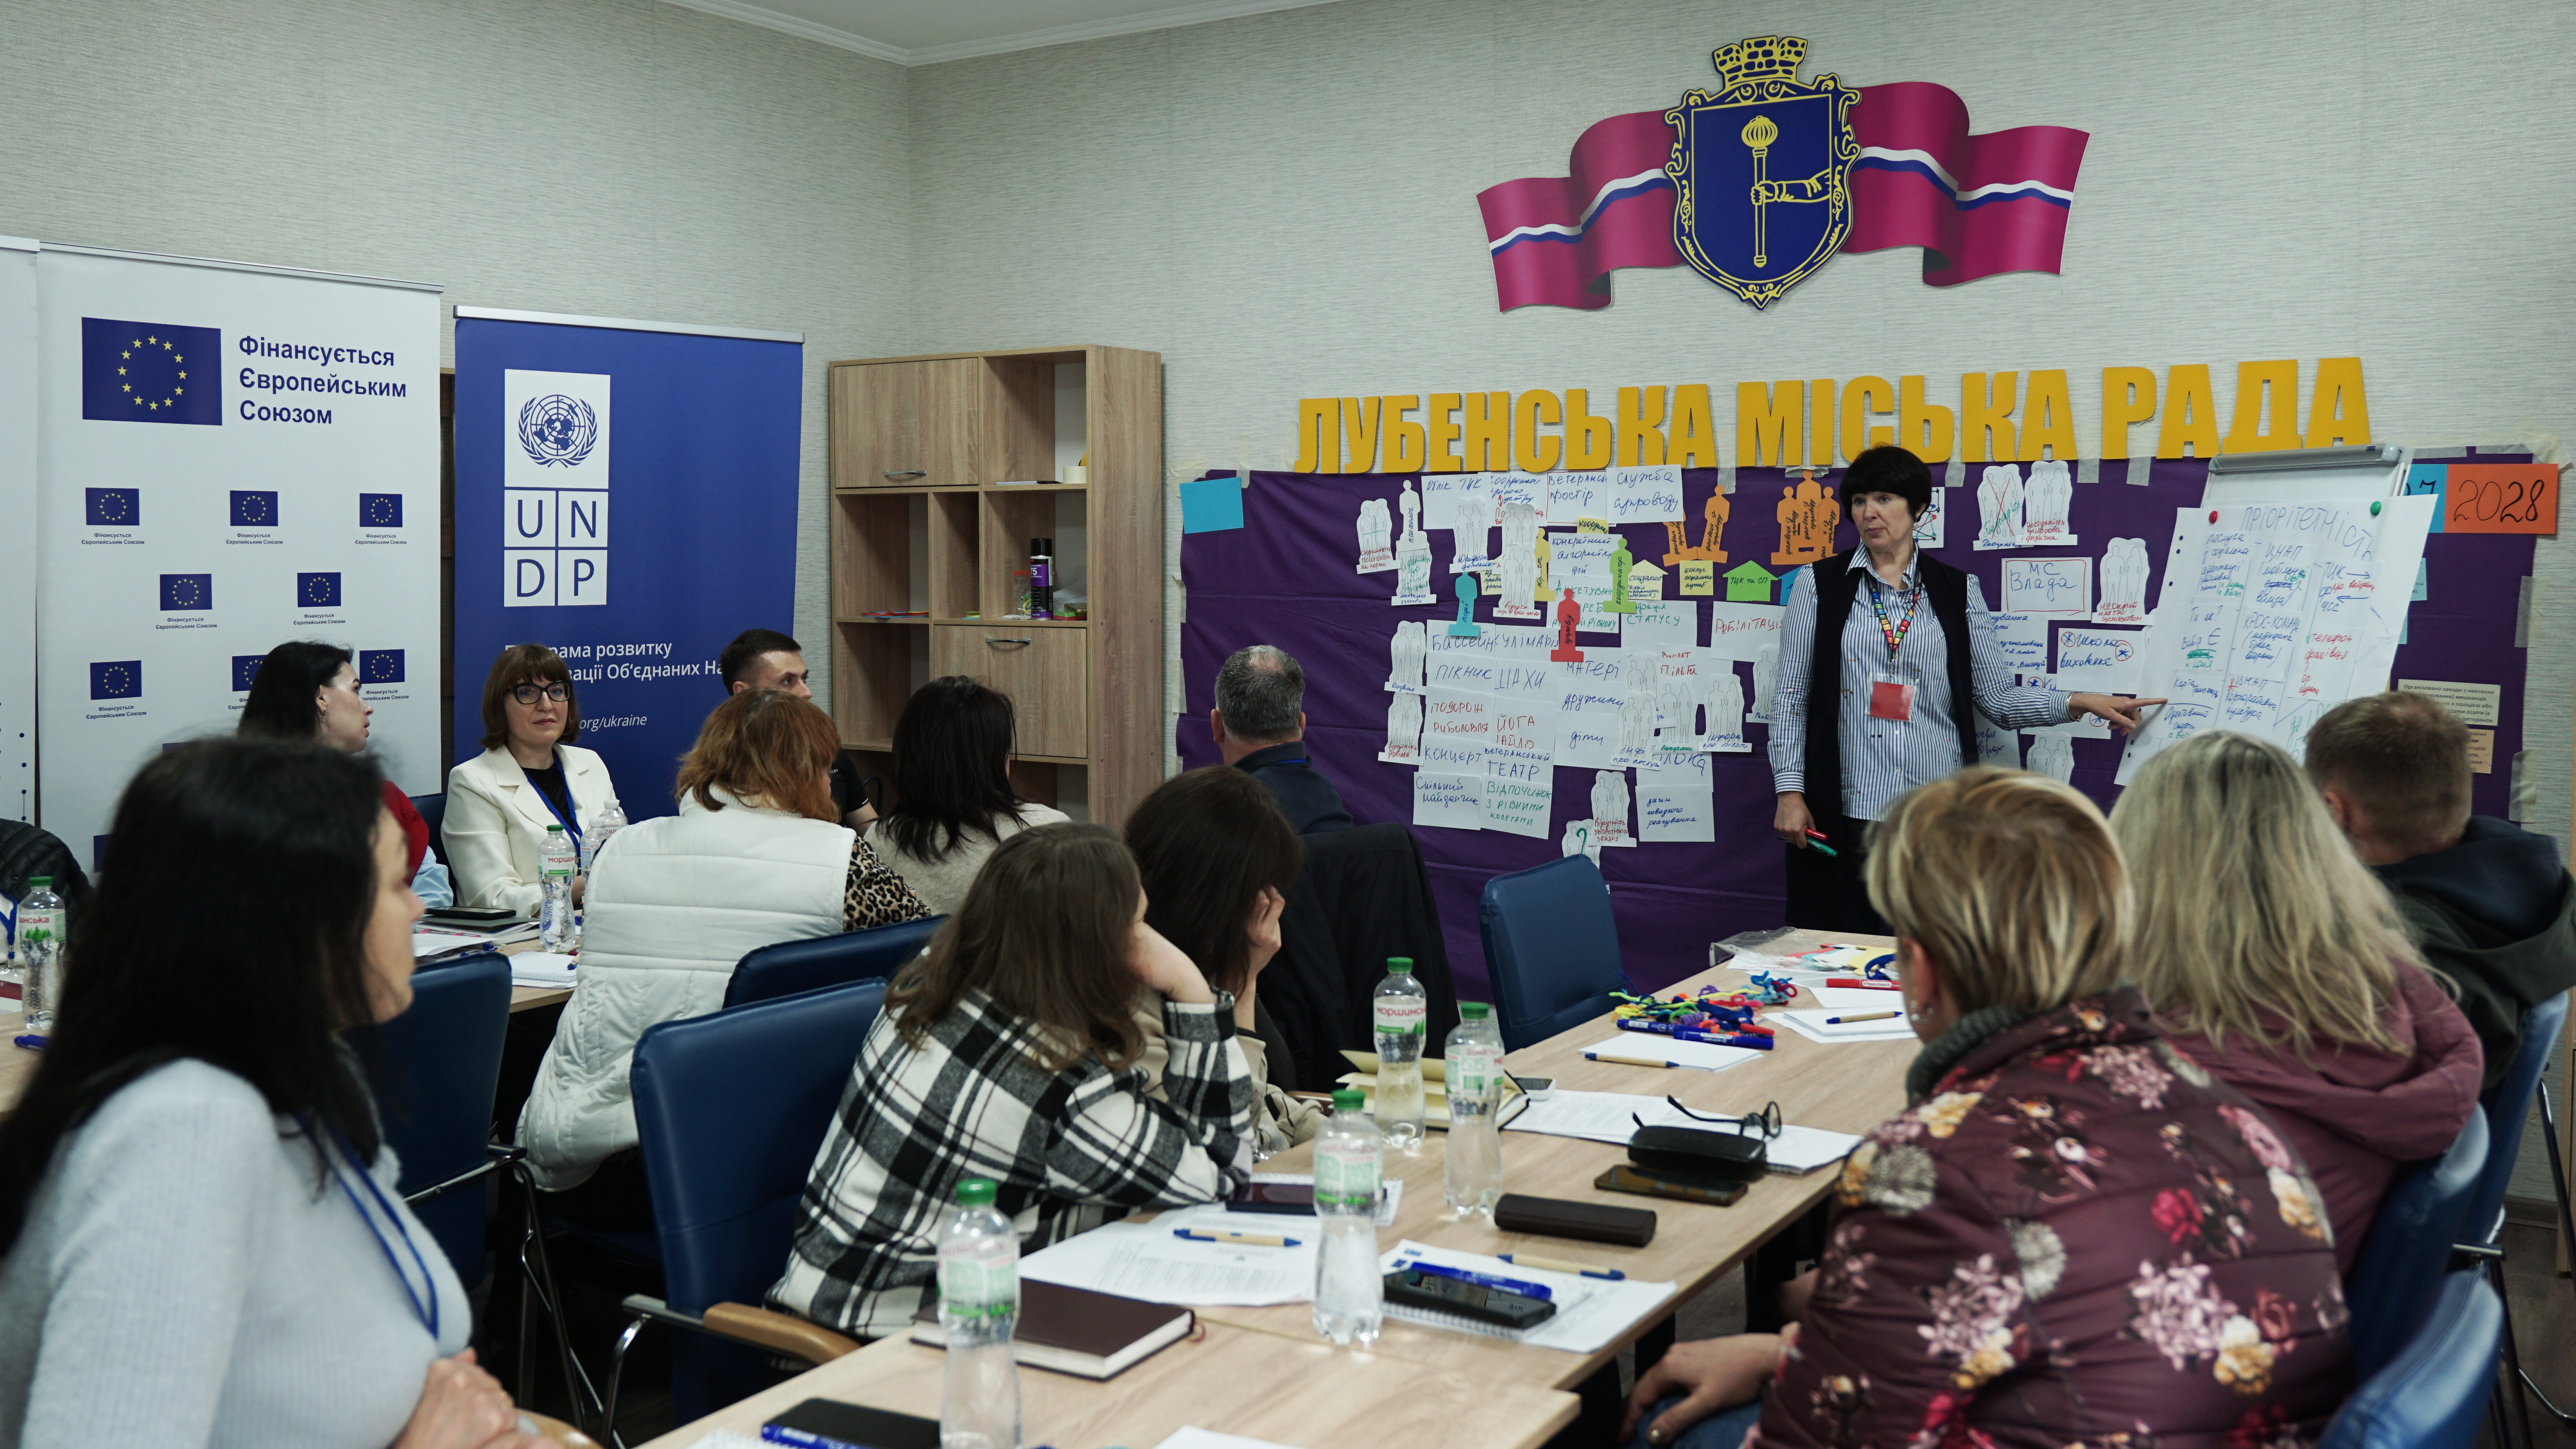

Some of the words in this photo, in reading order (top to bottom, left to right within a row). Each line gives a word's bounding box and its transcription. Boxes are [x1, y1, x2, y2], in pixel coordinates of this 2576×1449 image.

[239, 335, 394, 366] Фінансується
[239, 368, 407, 398] Європейським
[240, 399, 332, 425] Союзом
[1293, 383, 1717, 474] ЛУБЕНСЬКА
[1737, 369, 2078, 467] МІСЬКА
[2101, 357, 2371, 460] РАДА
[1617, 468, 1674, 488] Служба
[2454, 480, 2545, 522] 2028
[2010, 569, 2078, 601] Влада
[1627, 615, 1680, 626] СТАТУСУ
[596, 643, 673, 661] розвитку
[579, 714, 647, 732] org/ukraine
[1487, 760, 1540, 782] ТЕАТР
[548, 856, 575, 864] моршин
